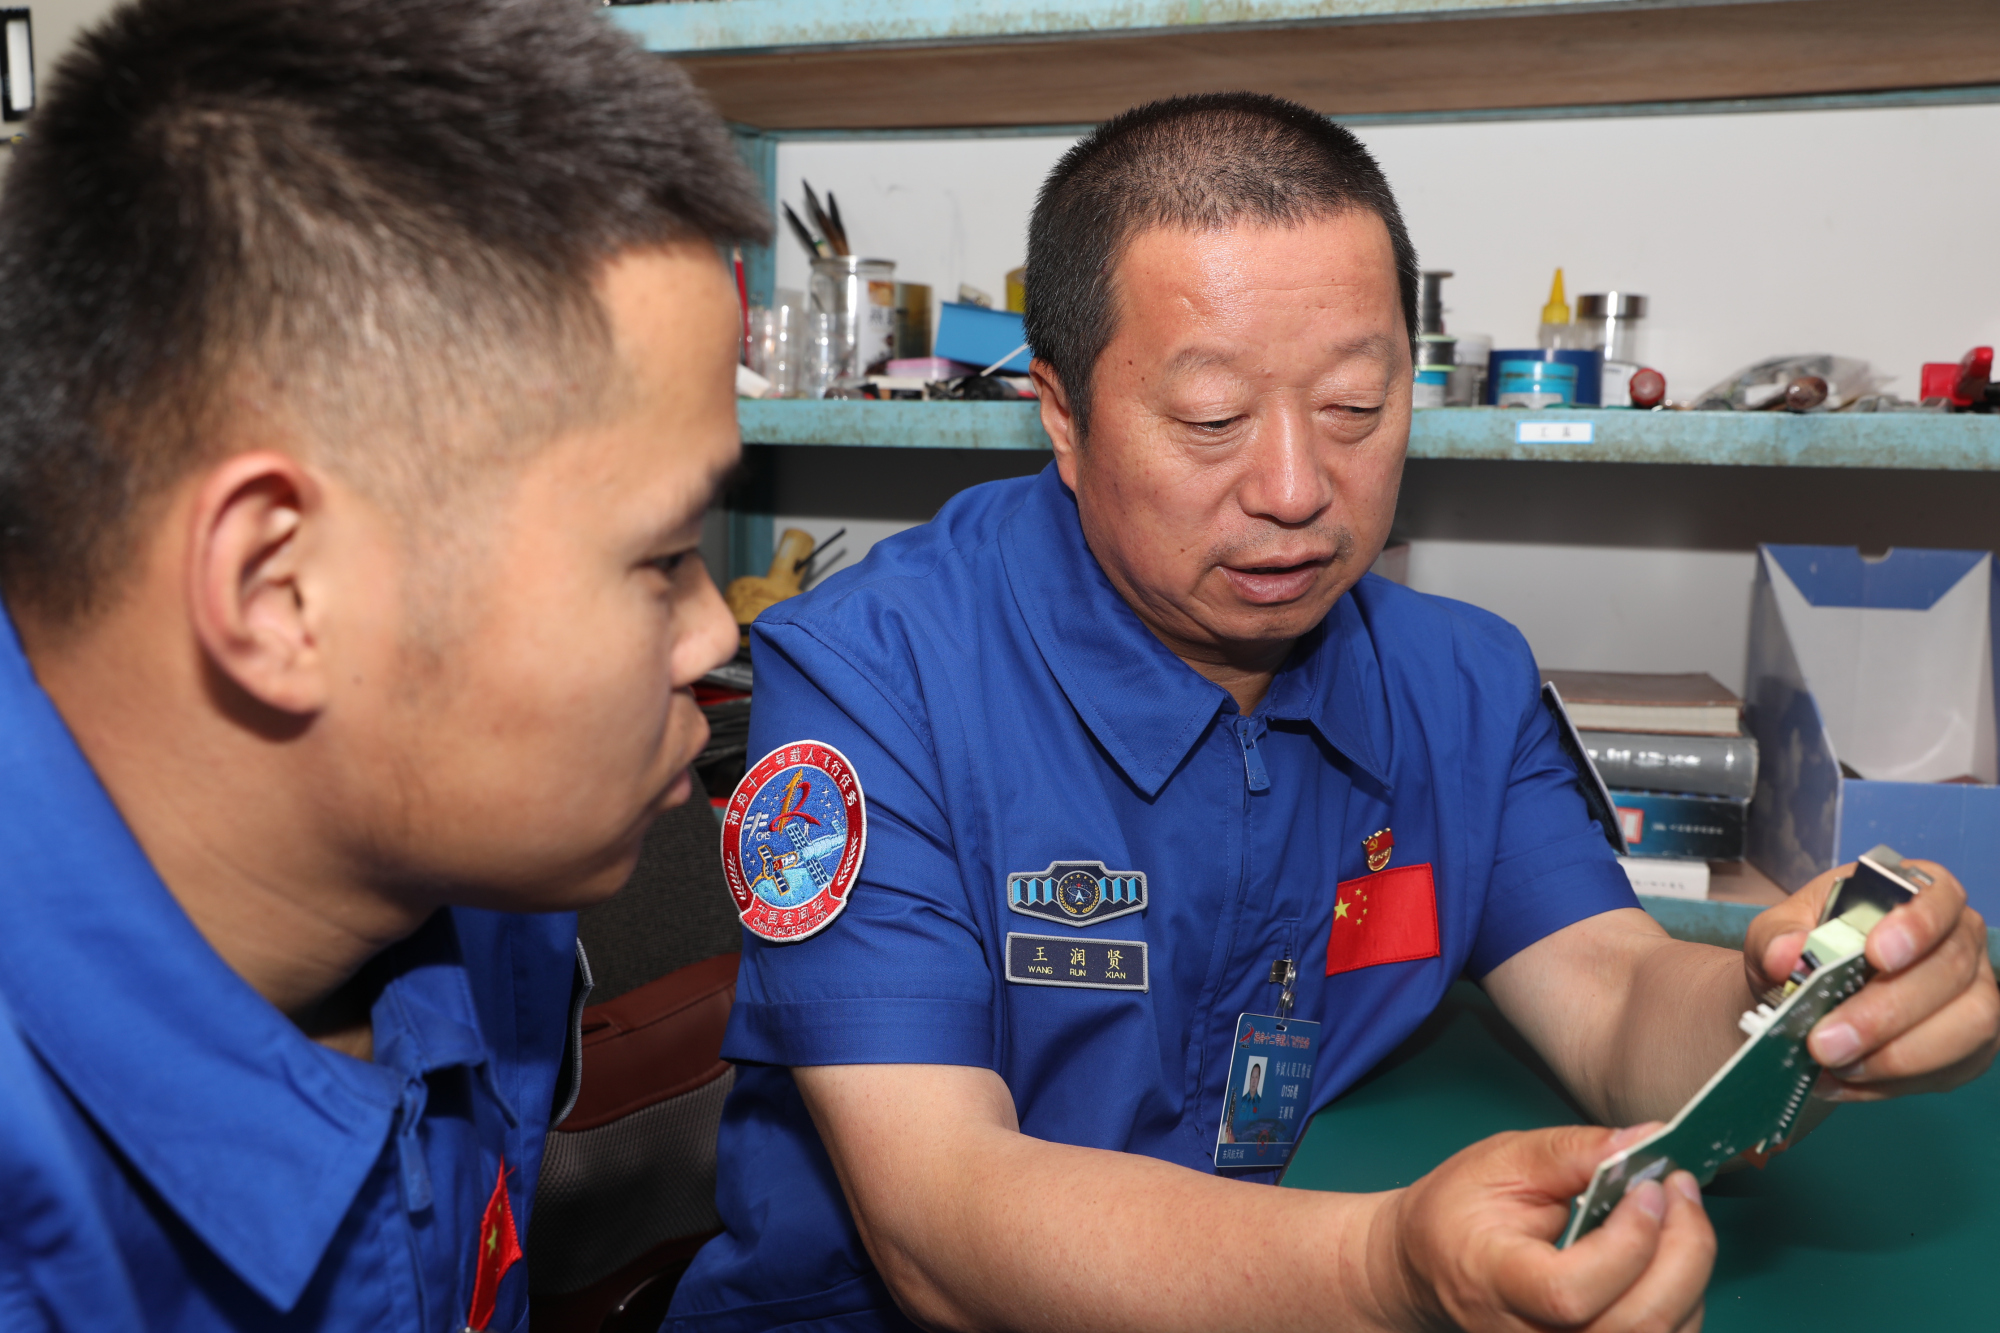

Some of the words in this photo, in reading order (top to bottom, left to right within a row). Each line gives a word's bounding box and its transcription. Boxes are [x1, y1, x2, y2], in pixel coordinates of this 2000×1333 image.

[752, 917, 772, 934] CHINA
[773, 925, 796, 936] SPACE
[796, 908, 828, 934] STATION
[755, 896, 825, 926] 中国空间站
[1032, 946, 1124, 970] 王润贤
[1028, 965, 1053, 975] WANG
[1069, 968, 1087, 977] RUN
[1105, 971, 1127, 980] XIAN
